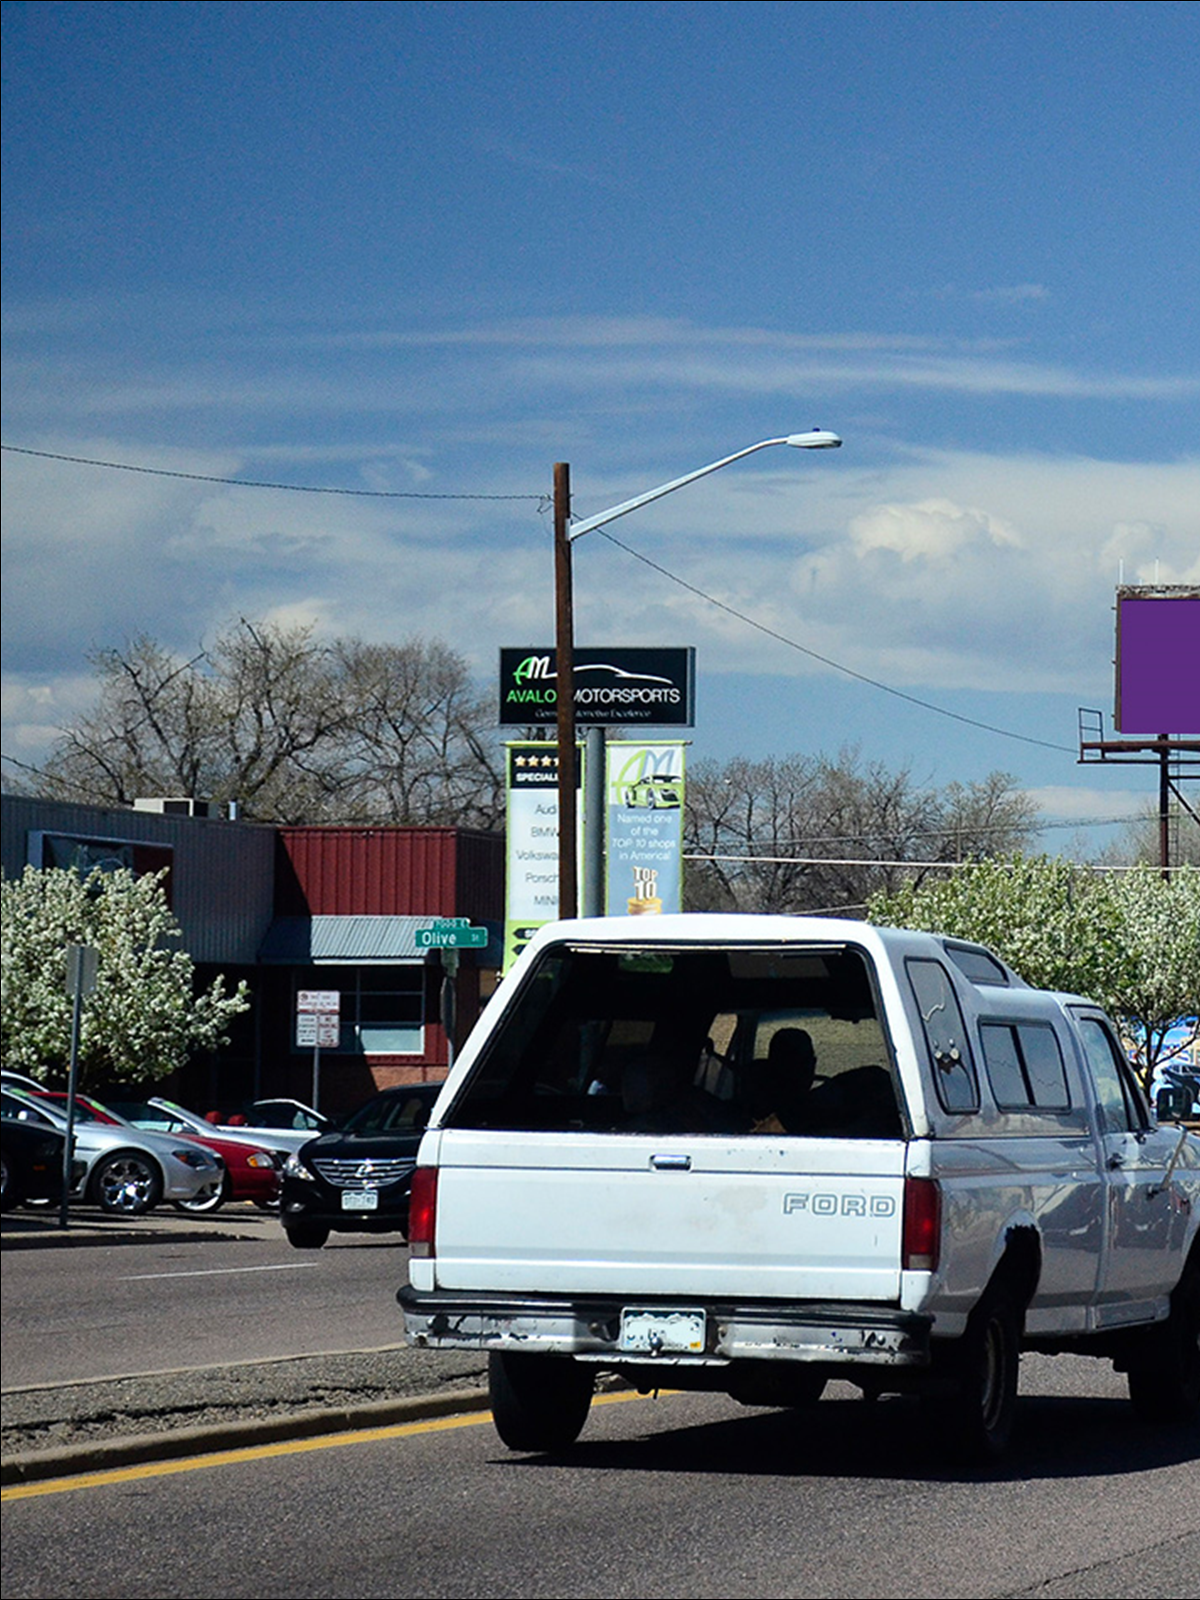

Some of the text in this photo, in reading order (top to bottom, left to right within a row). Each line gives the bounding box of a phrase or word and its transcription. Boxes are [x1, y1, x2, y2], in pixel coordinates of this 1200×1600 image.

[506, 689, 558, 703] AVALO
[617, 814, 673, 824] Named one
[630, 826, 659, 836] of the
[633, 866, 658, 882] TOP
[634, 881, 657, 900] 10
[422, 931, 457, 945] Olive
[783, 1193, 896, 1218] FORD
